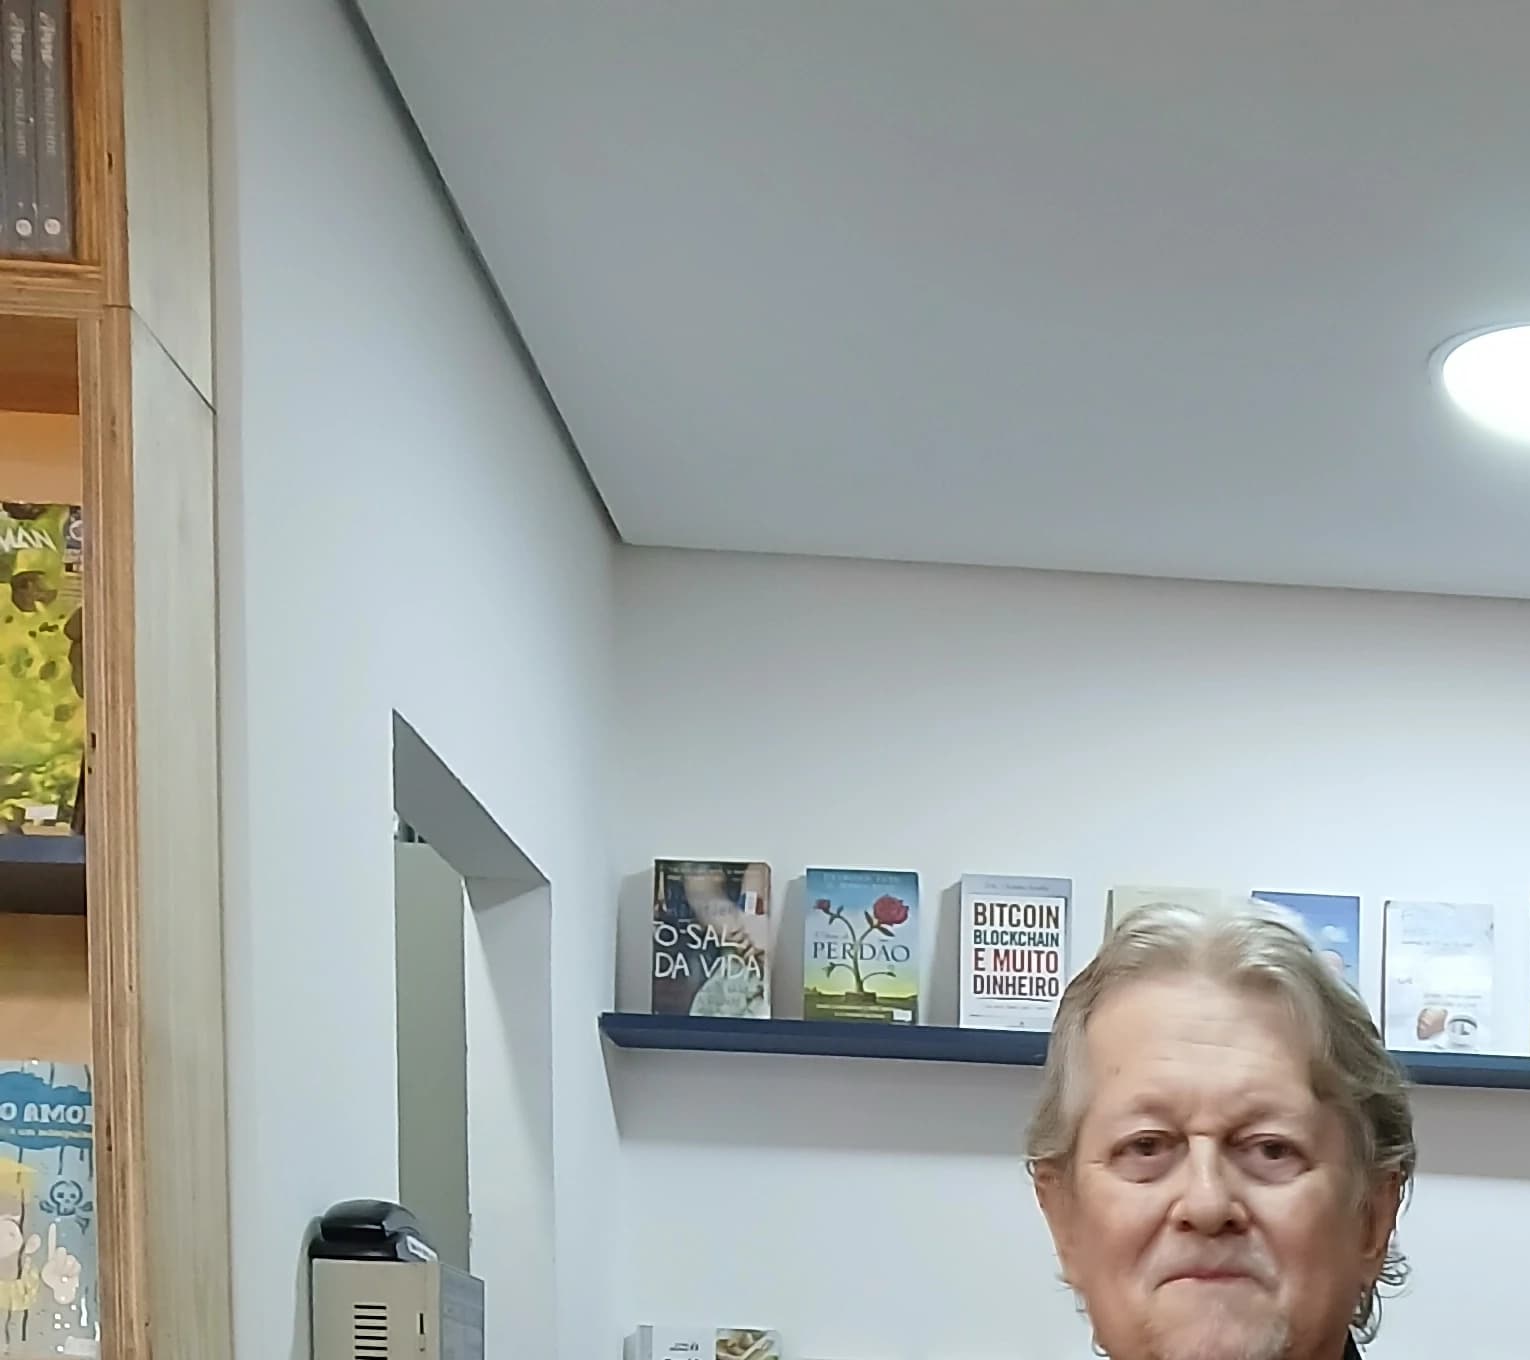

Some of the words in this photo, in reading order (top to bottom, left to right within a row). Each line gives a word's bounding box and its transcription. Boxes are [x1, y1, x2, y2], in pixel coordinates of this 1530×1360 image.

[973, 902, 1060, 929] BITCOIN
[654, 924, 679, 947] O
[686, 924, 747, 950] SAL
[973, 929, 1060, 947] BLOCKCHAIN
[812, 938, 911, 963] PERDÃO
[973, 948, 986, 972] E
[993, 949, 1059, 974] MUITO
[654, 952, 690, 980] DA
[699, 953, 761, 980] VIDA
[973, 974, 1060, 998] DINHEIRO
